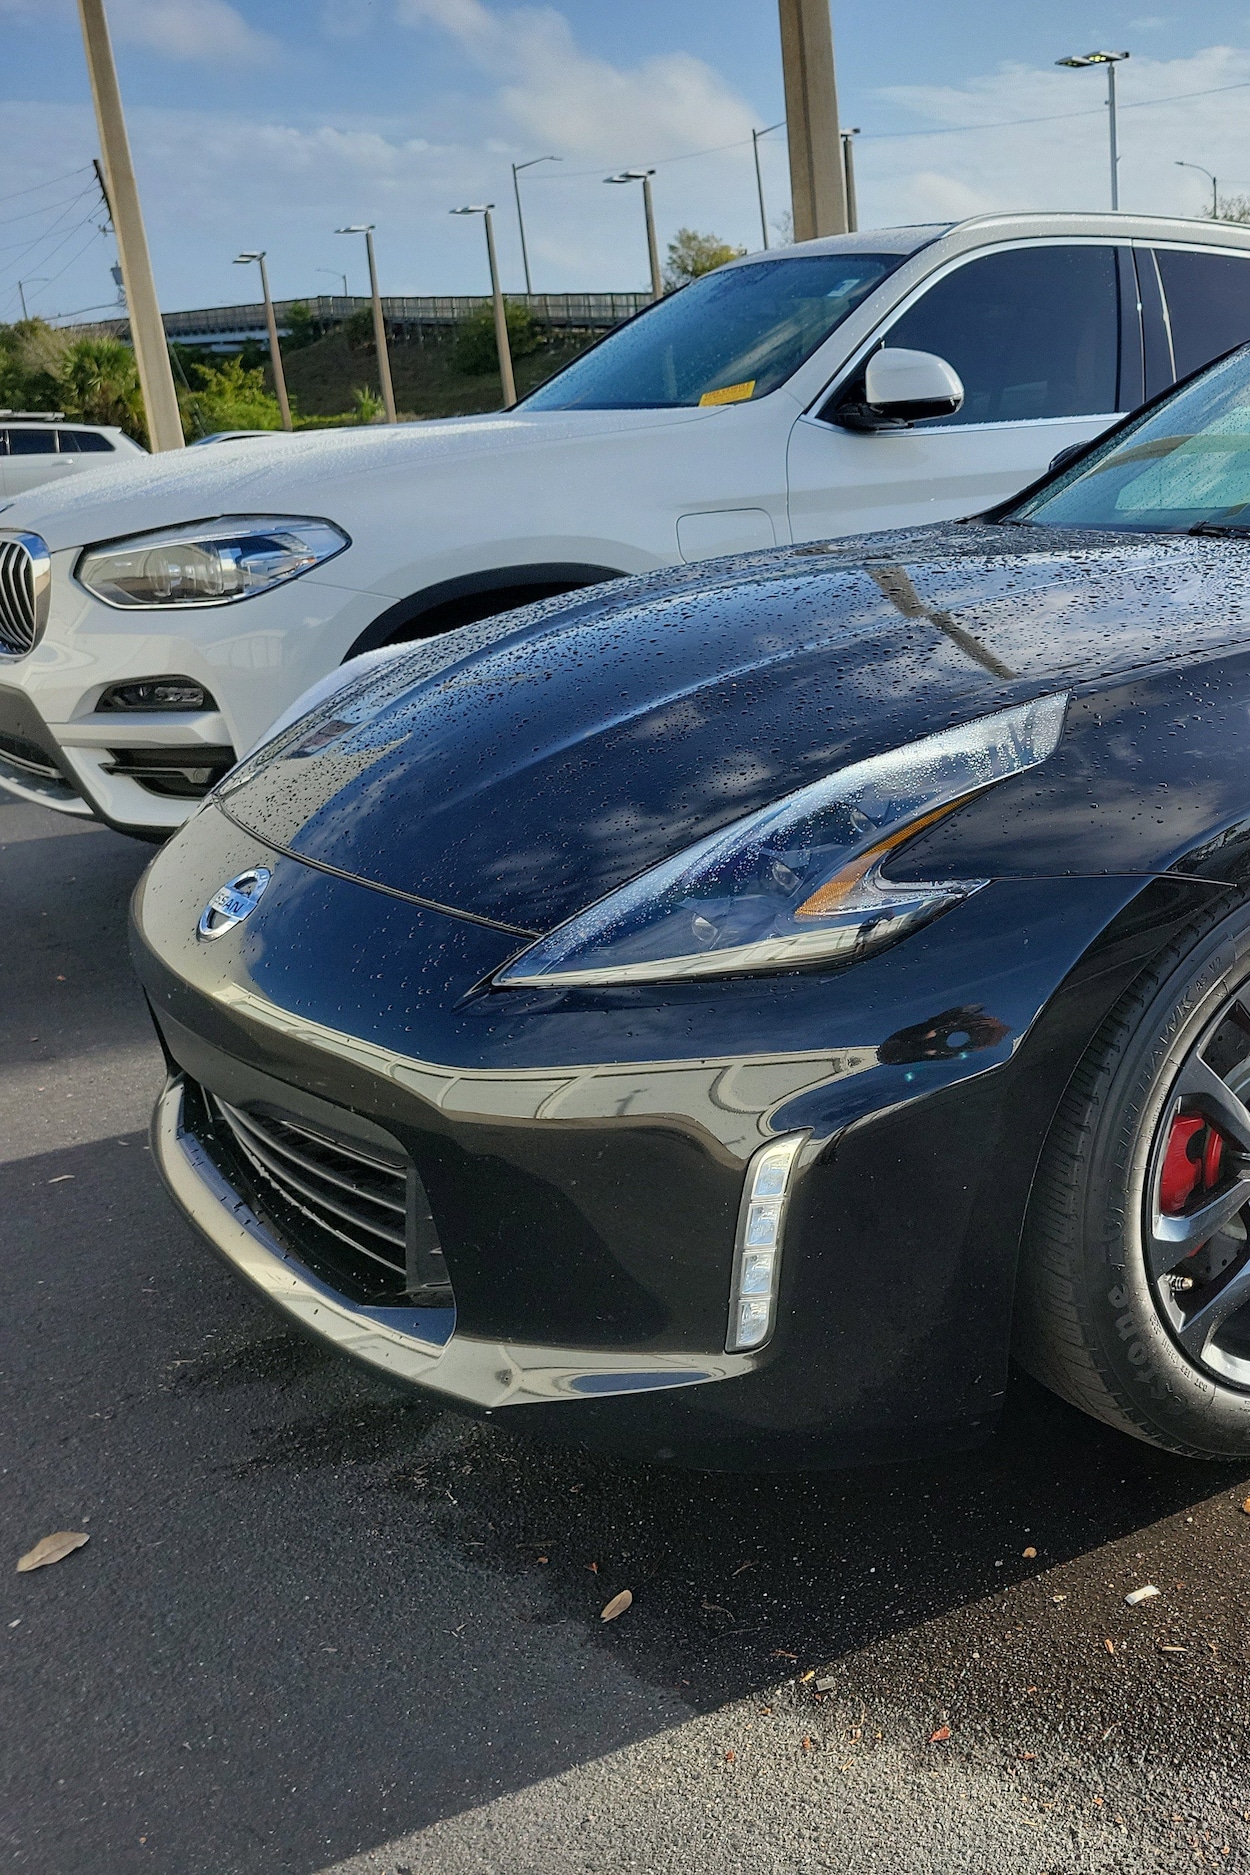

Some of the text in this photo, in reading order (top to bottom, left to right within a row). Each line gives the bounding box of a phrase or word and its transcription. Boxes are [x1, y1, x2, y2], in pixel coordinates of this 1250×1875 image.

[214, 893, 245, 913] SSAN
[1192, 970, 1208, 993] AS
[1208, 954, 1223, 975] V2
[1193, 1376, 1209, 1393] DOT
